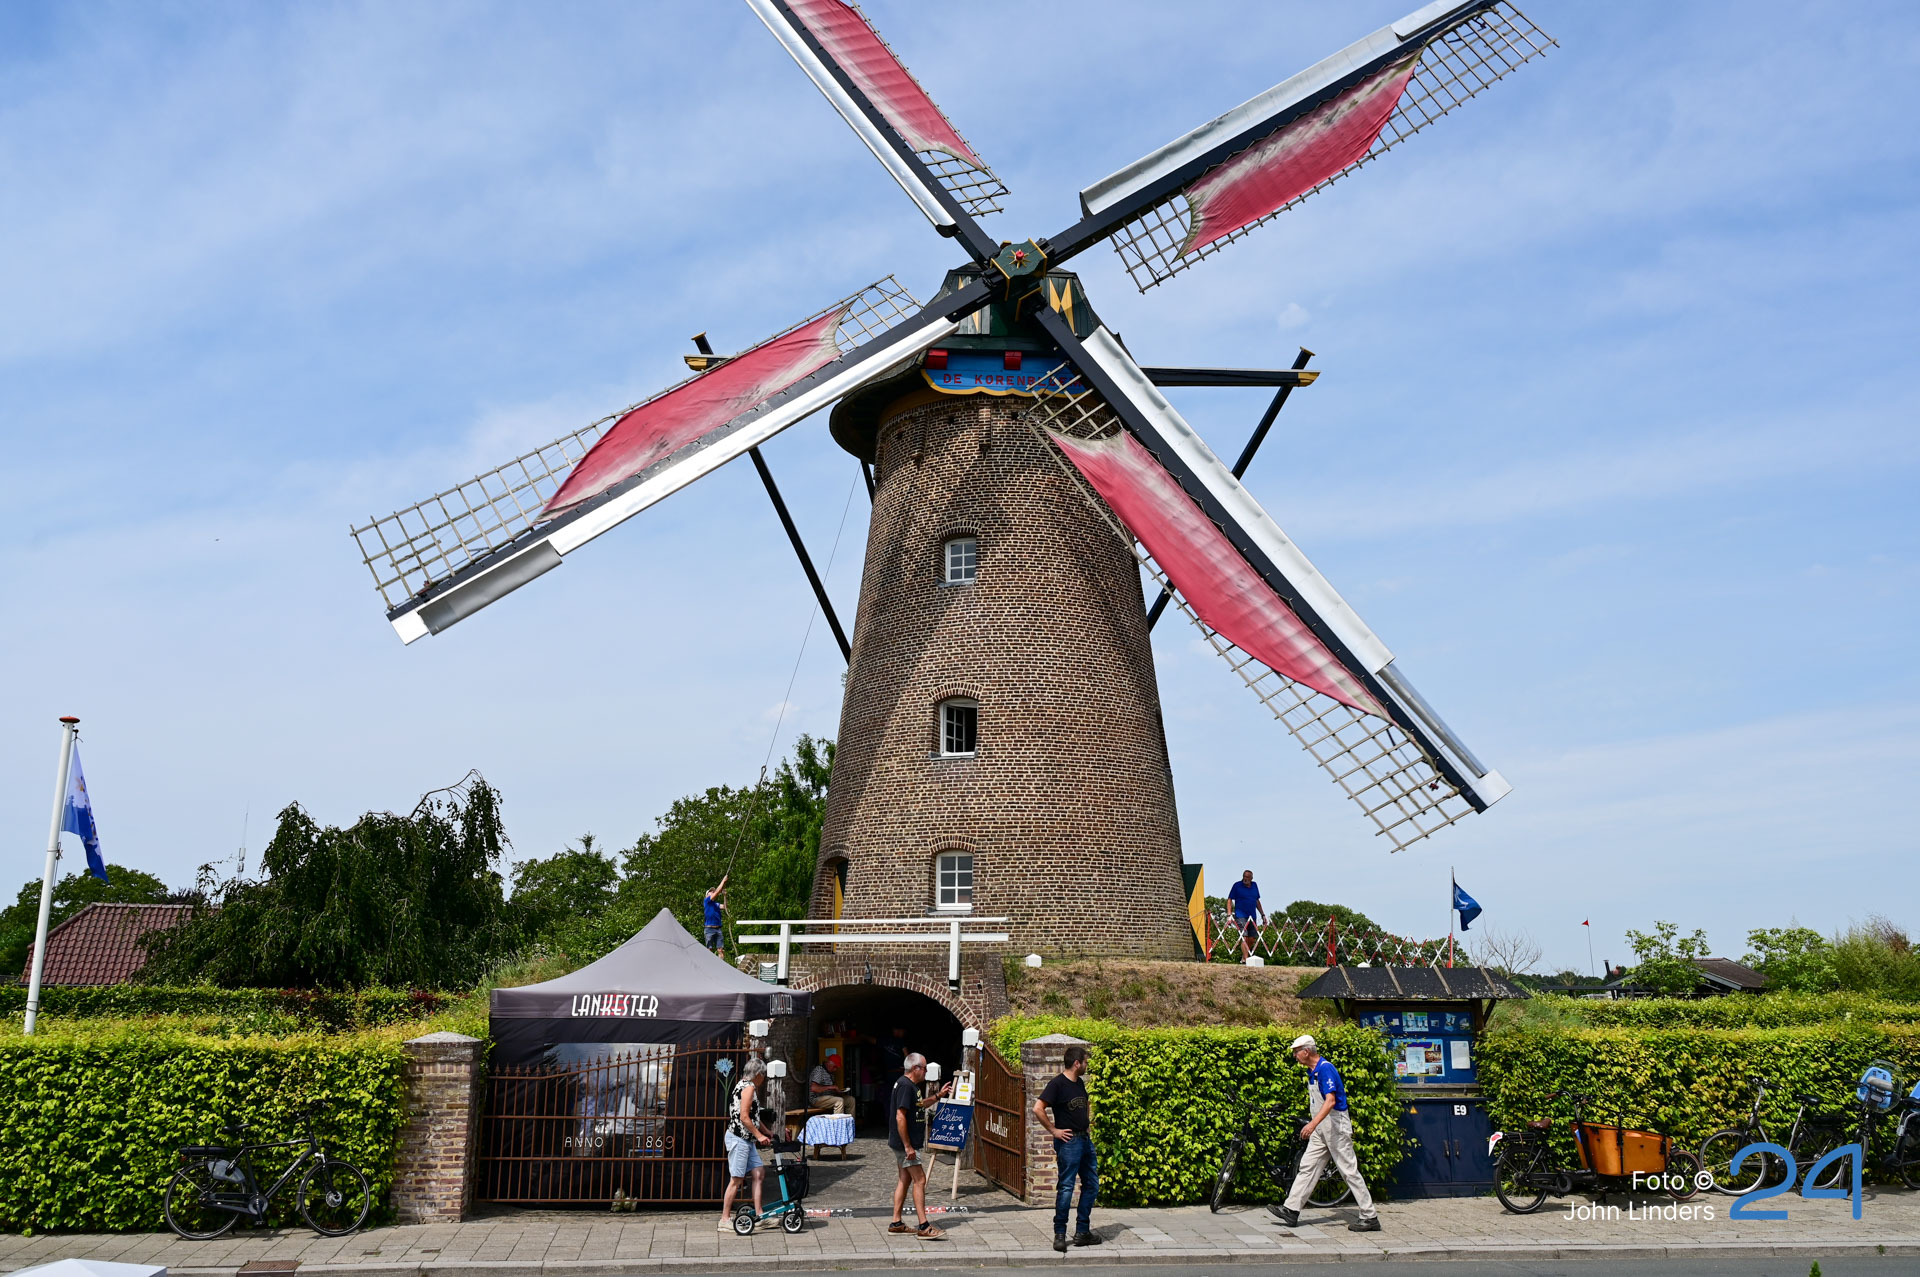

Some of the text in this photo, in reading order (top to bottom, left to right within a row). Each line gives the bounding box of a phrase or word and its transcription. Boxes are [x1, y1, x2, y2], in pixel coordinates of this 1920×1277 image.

[943, 373, 963, 384] DE
[571, 994, 659, 1017] LANKESTER
[1453, 1104, 1467, 1116] E9
[564, 1136, 675, 1150] ANNO 1869
